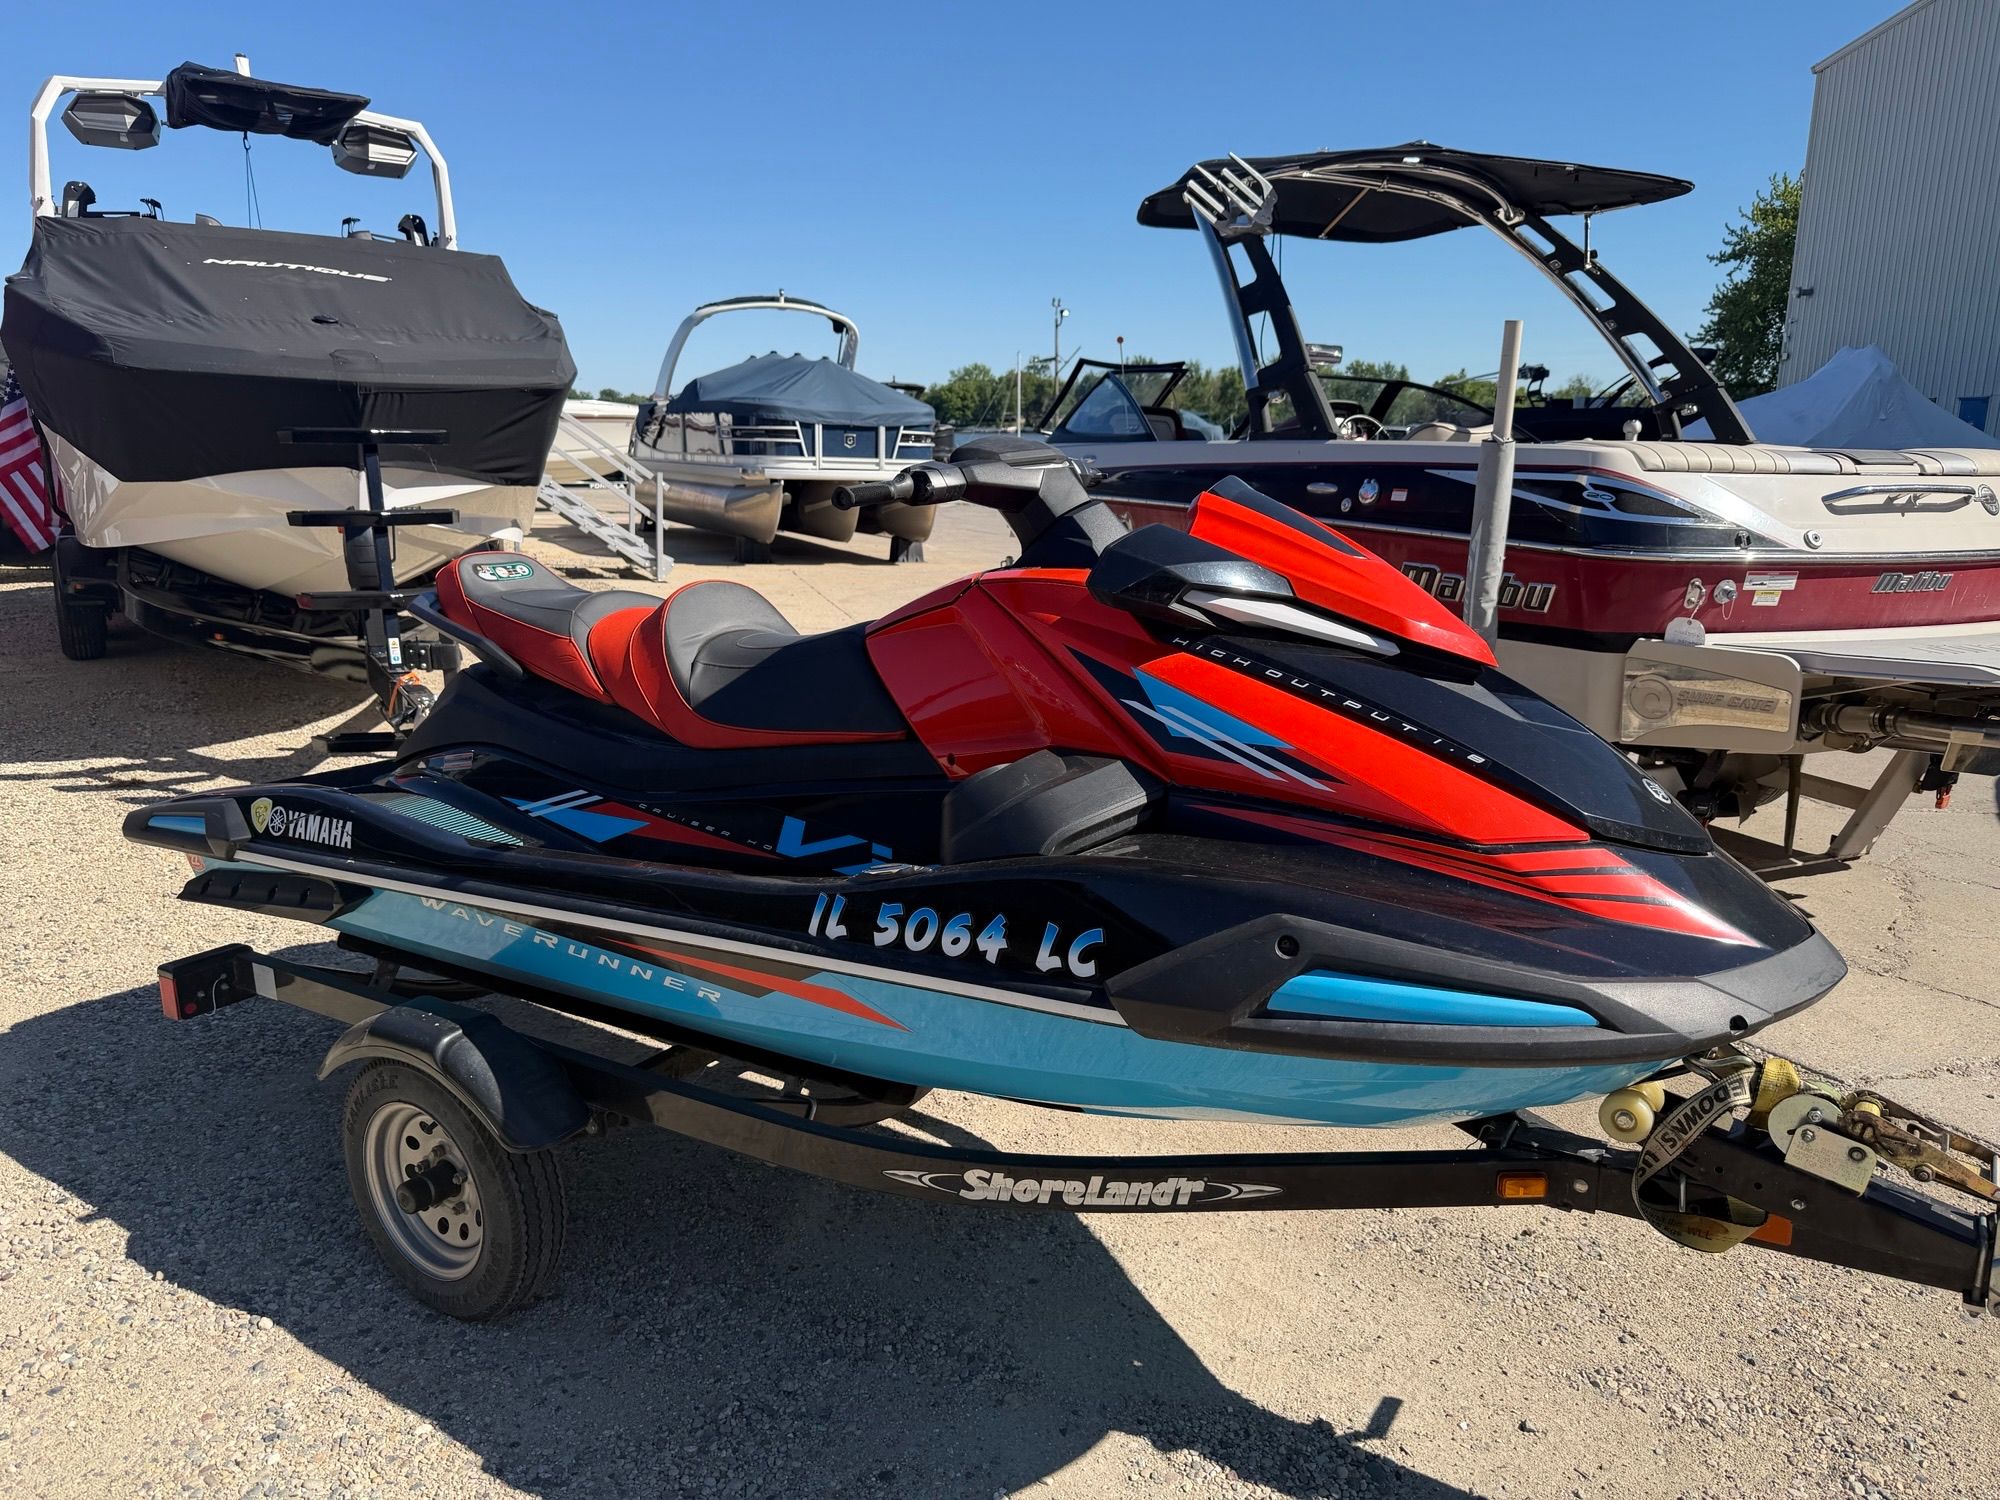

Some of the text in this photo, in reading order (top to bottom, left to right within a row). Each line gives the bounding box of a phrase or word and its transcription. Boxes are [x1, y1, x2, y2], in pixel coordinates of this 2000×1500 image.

[202, 258, 390, 282] NAUTIQUE
[1401, 561, 1556, 614] Mabu
[1872, 570, 1954, 593] Malibu
[1173, 637, 1251, 666] HIGH
[1264, 669, 1417, 732] OUTPUT
[1677, 690, 1775, 712] SURF GATE
[288, 810, 353, 849] YAMAHA
[638, 802, 731, 836] CRUISER
[420, 896, 722, 1003] WAVERUNNER
[808, 892, 1104, 978] IL 5064 LC
